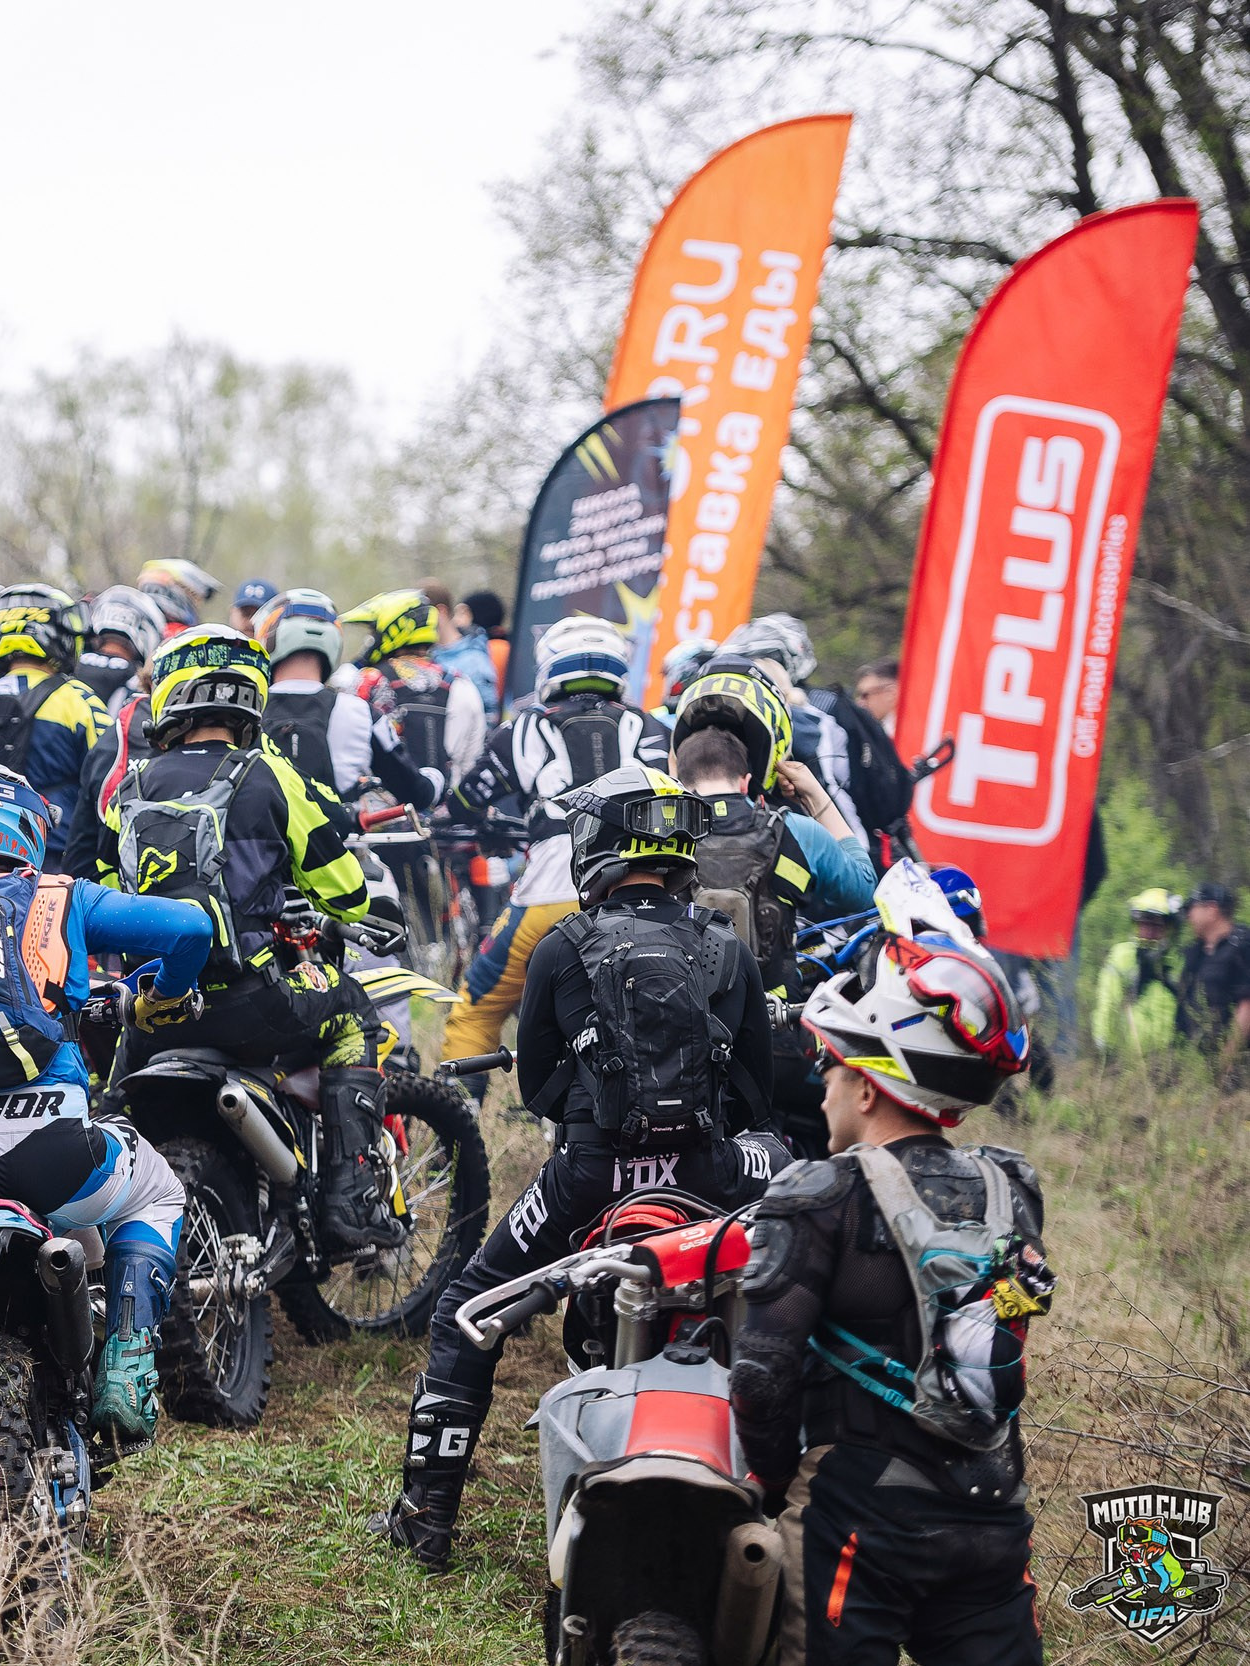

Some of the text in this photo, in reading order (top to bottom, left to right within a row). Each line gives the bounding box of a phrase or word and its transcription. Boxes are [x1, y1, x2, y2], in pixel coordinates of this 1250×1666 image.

[947, 434, 1085, 808] TPLUS
[743, 1145, 772, 1181] FOX
[510, 1187, 549, 1254] FOX
[438, 1427, 470, 1457] G
